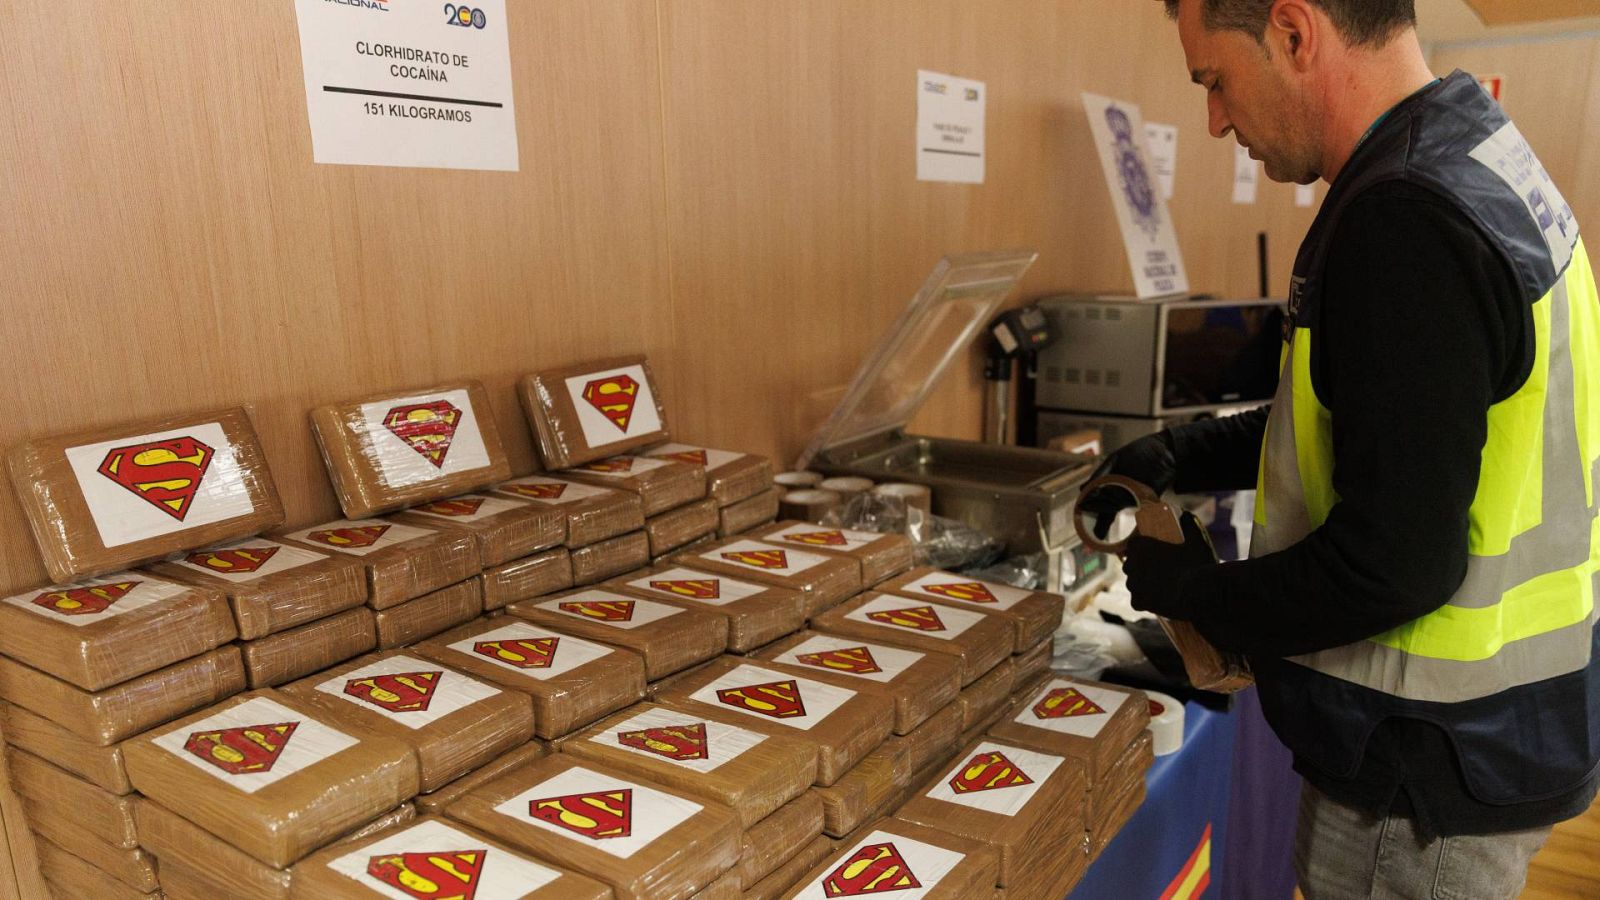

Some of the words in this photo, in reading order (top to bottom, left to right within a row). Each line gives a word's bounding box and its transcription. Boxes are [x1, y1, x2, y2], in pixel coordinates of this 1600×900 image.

[356, 41, 449, 65] CLORHIDRATO
[453, 54, 469, 68] DE
[390, 64, 448, 82] COCAÍNA
[364, 102, 384, 116] 151
[389, 104, 472, 123] KILOGRAMOS
